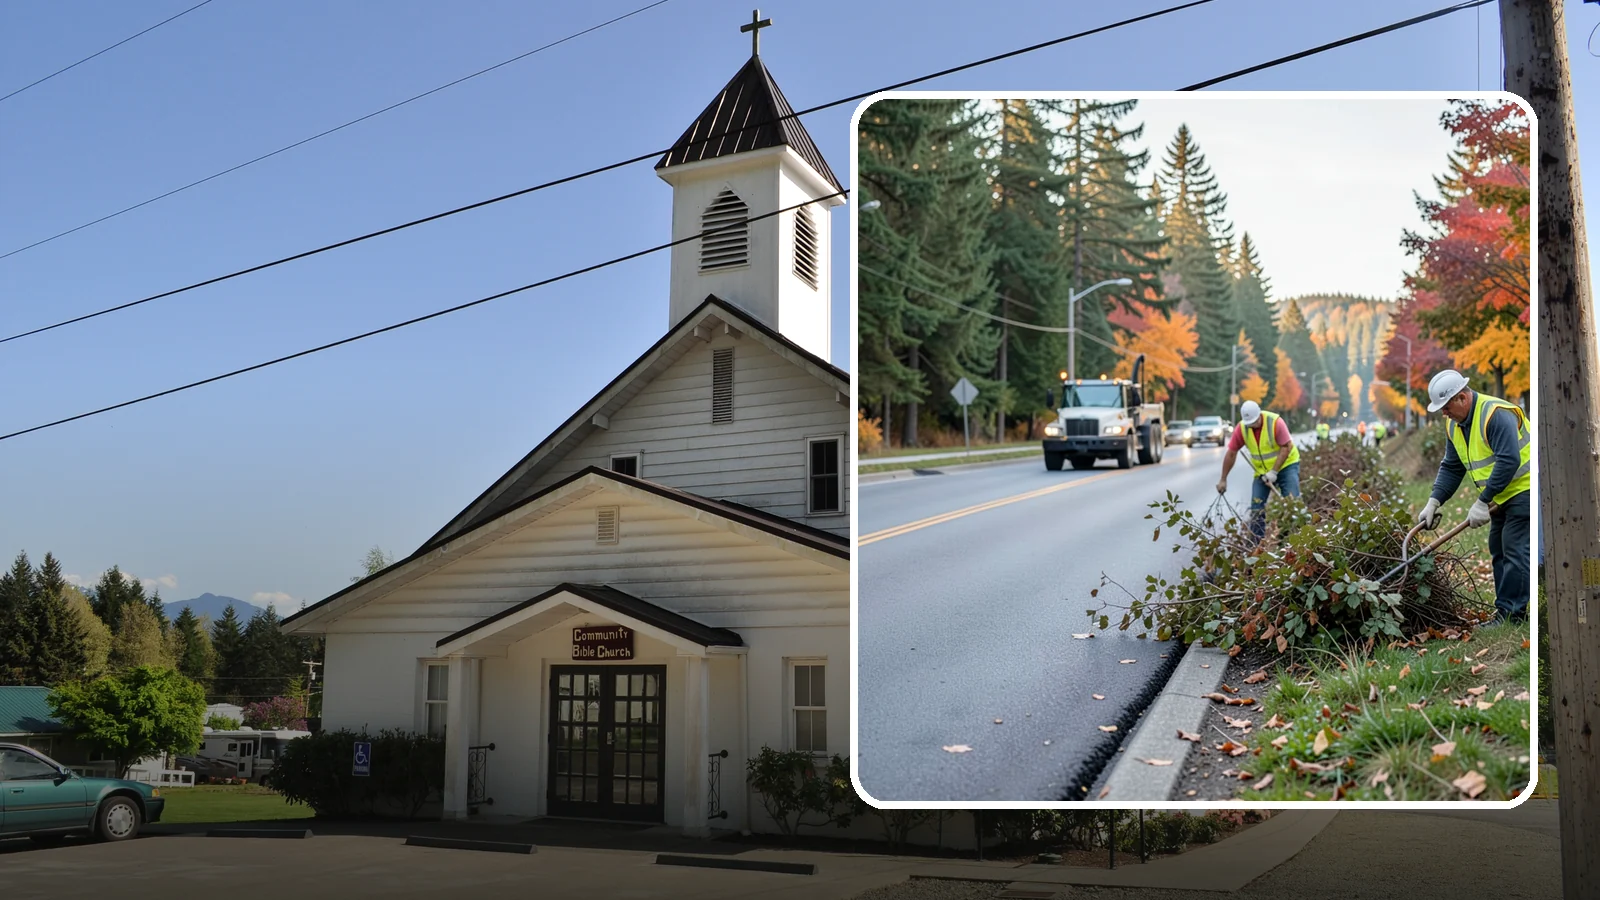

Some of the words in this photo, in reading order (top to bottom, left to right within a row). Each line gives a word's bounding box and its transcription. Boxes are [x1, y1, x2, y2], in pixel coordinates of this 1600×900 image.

[574, 627, 628, 641] Community
[572, 644, 595, 657] Bible
[597, 645, 631, 658] Church
